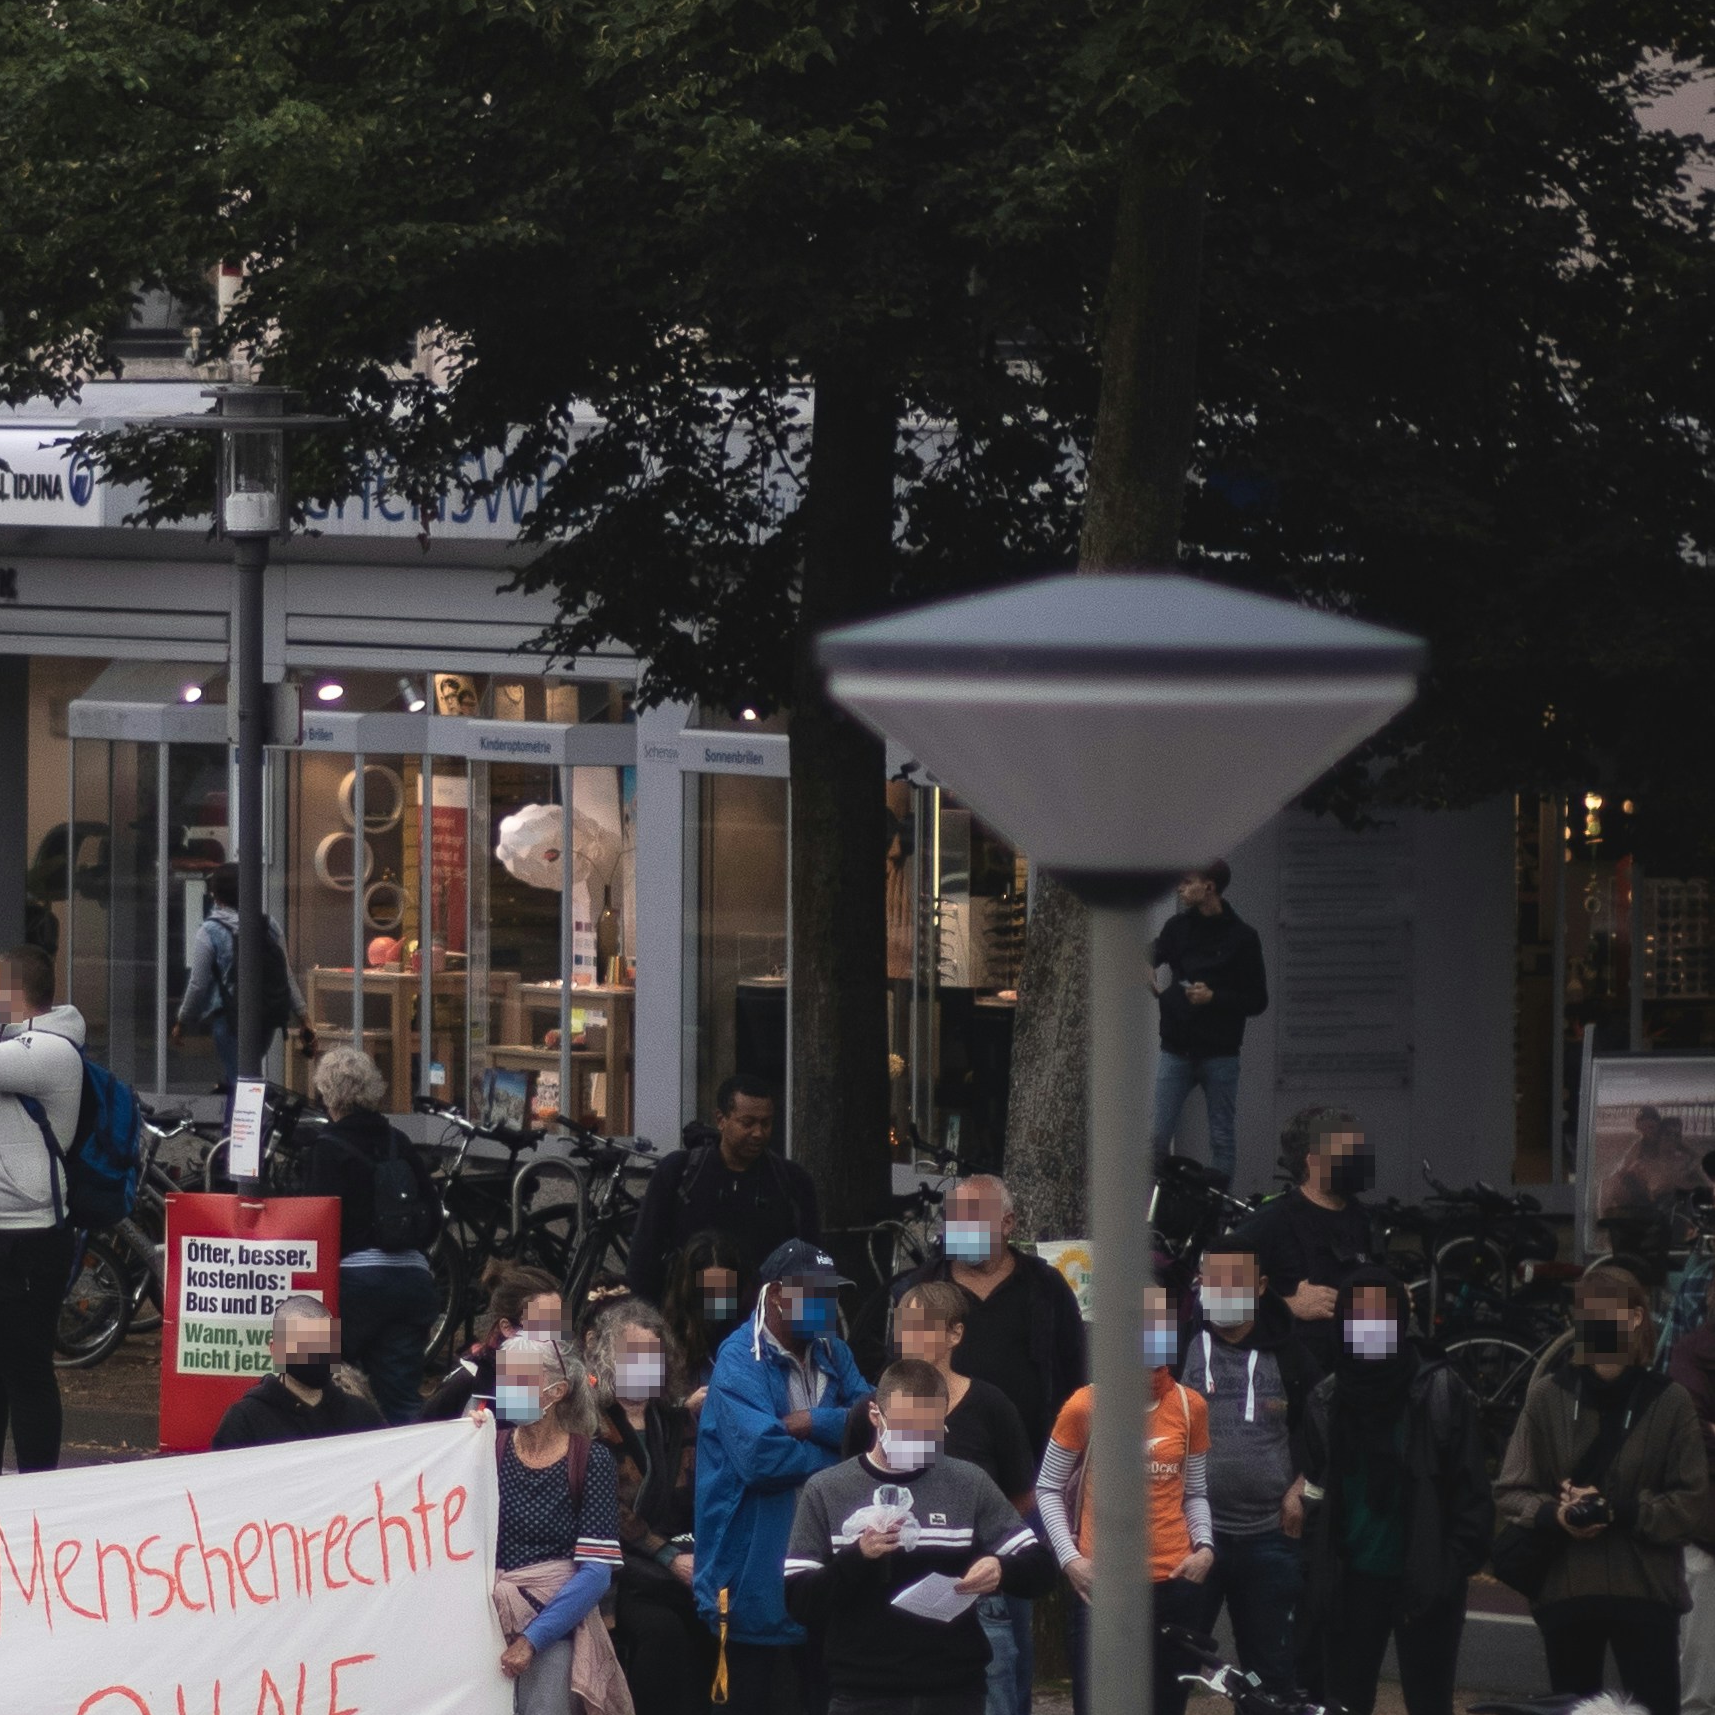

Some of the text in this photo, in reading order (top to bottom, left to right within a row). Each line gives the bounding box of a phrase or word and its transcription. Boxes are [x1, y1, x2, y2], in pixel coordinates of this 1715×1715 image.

[13, 473, 64, 501] IDUNA
[705, 748, 764, 765] Sonnenbrillen
[187, 1239, 311, 1269] Öfter, besser,
[187, 1267, 286, 1291] kostenlos:
[186, 1291, 218, 1313] Bus
[221, 1295, 257, 1315] und
[185, 1322, 274, 1347] Wann, we
[184, 1348, 273, 1372] nicht jetz
